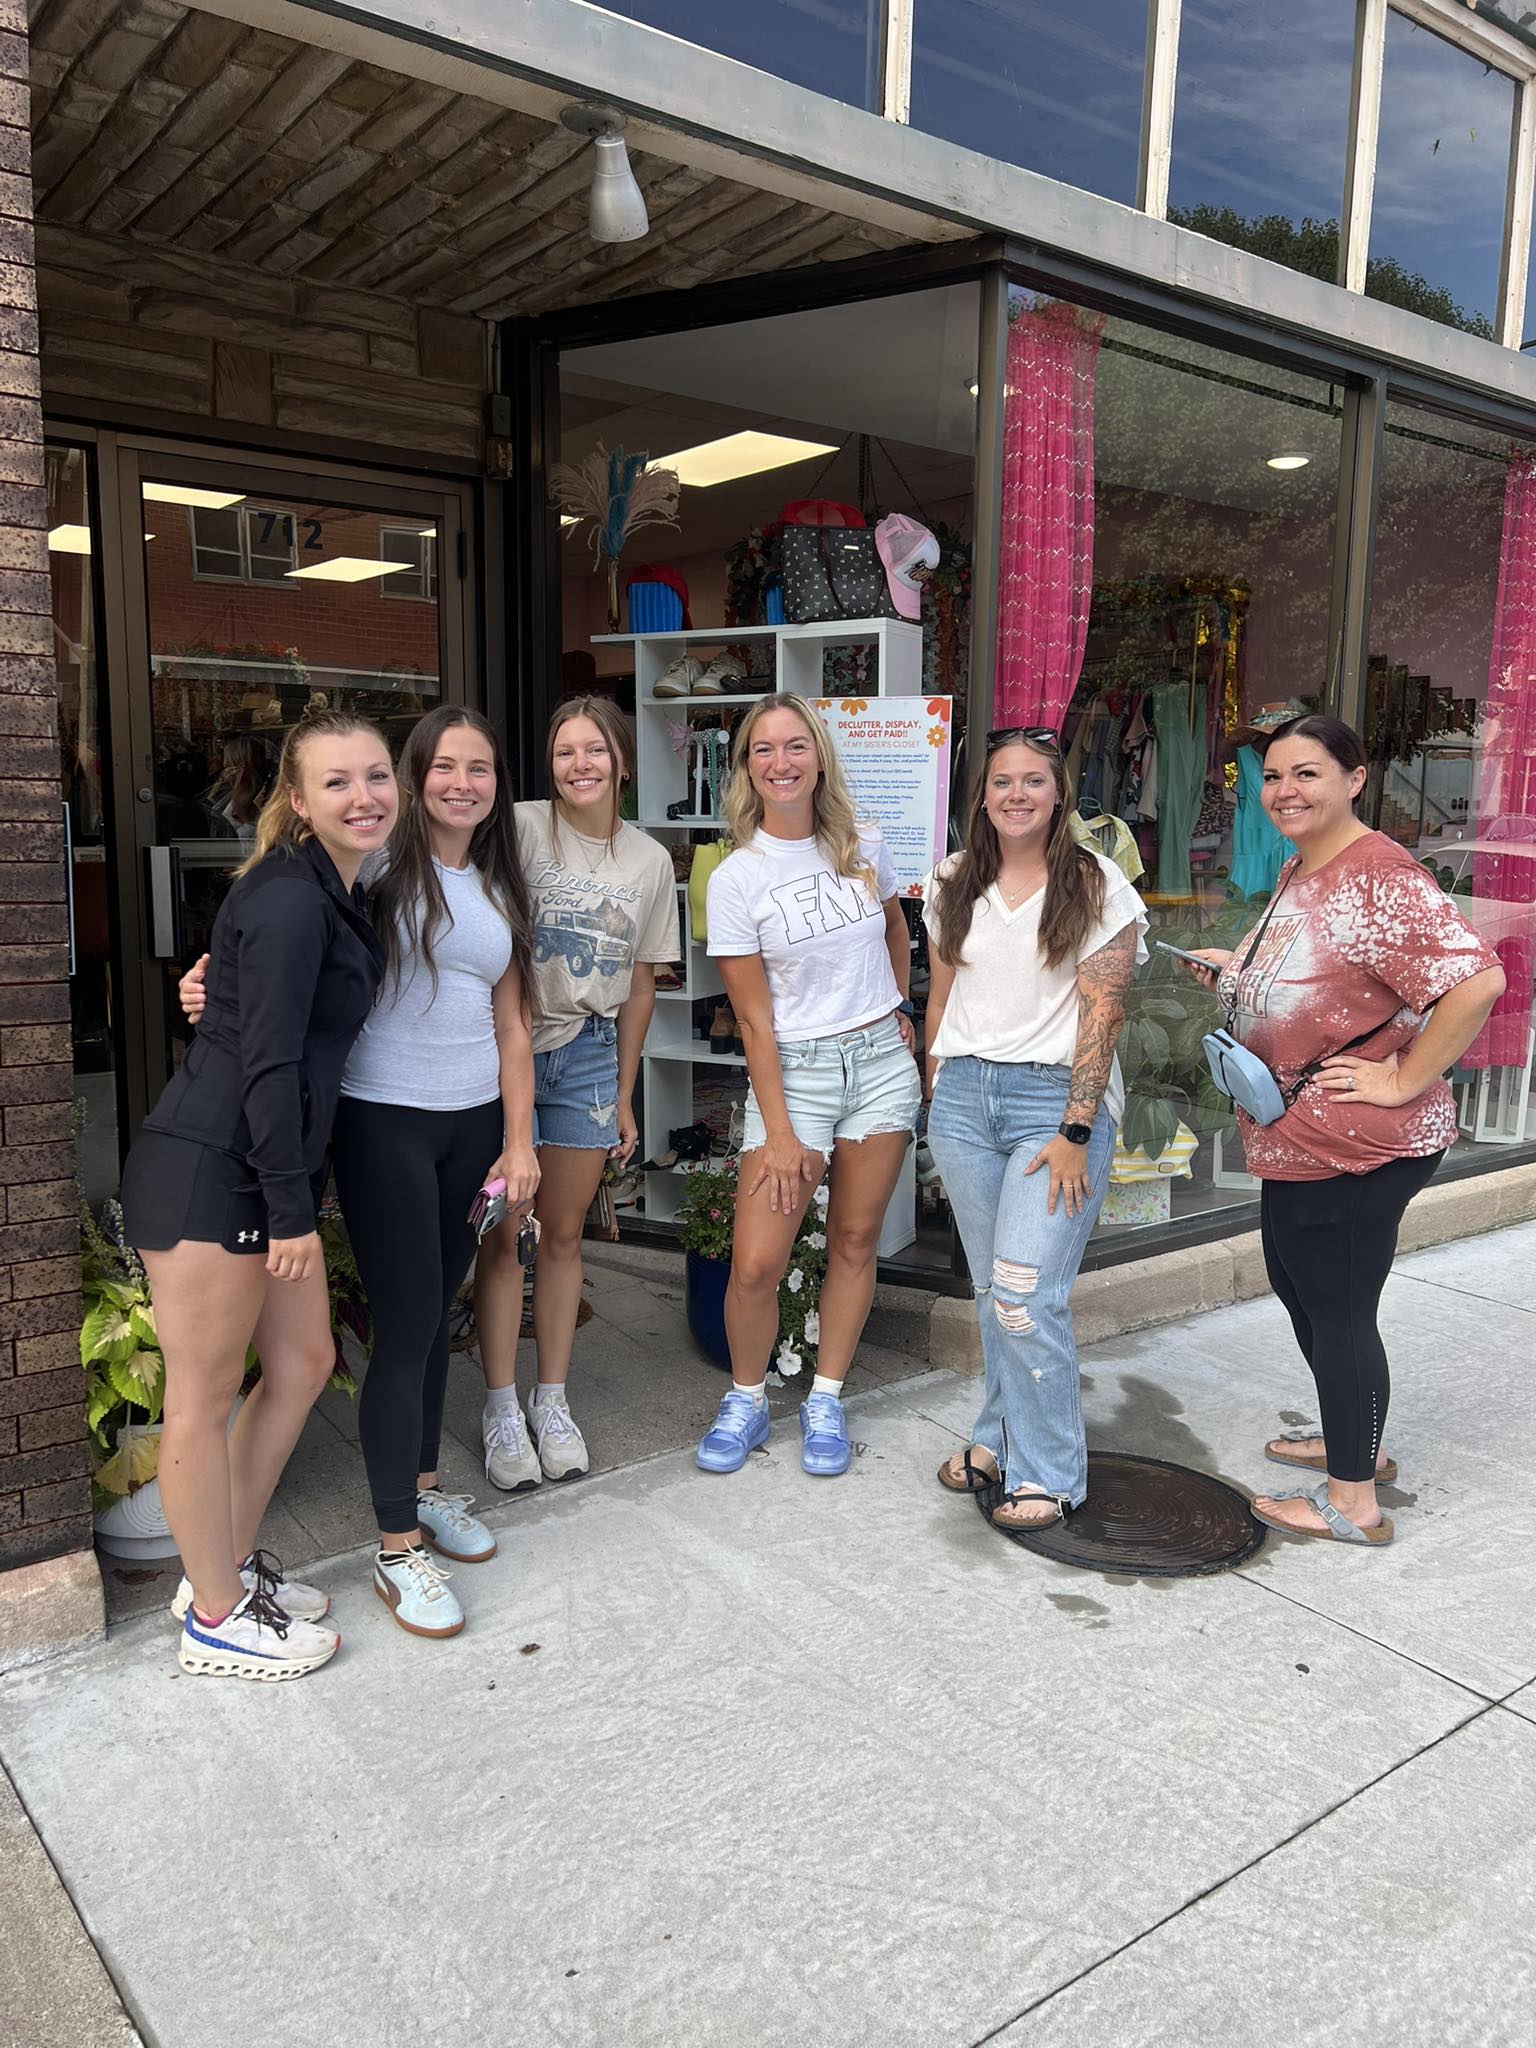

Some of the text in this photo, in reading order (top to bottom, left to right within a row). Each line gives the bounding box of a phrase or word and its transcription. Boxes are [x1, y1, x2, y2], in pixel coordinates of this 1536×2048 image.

[258, 512, 323, 550] 712
[838, 721, 883, 729] DECLUTTER,
[848, 730, 908, 738] AND GET PAID!!
[528, 859, 642, 902] Bronco
[543, 888, 583, 908] Ford
